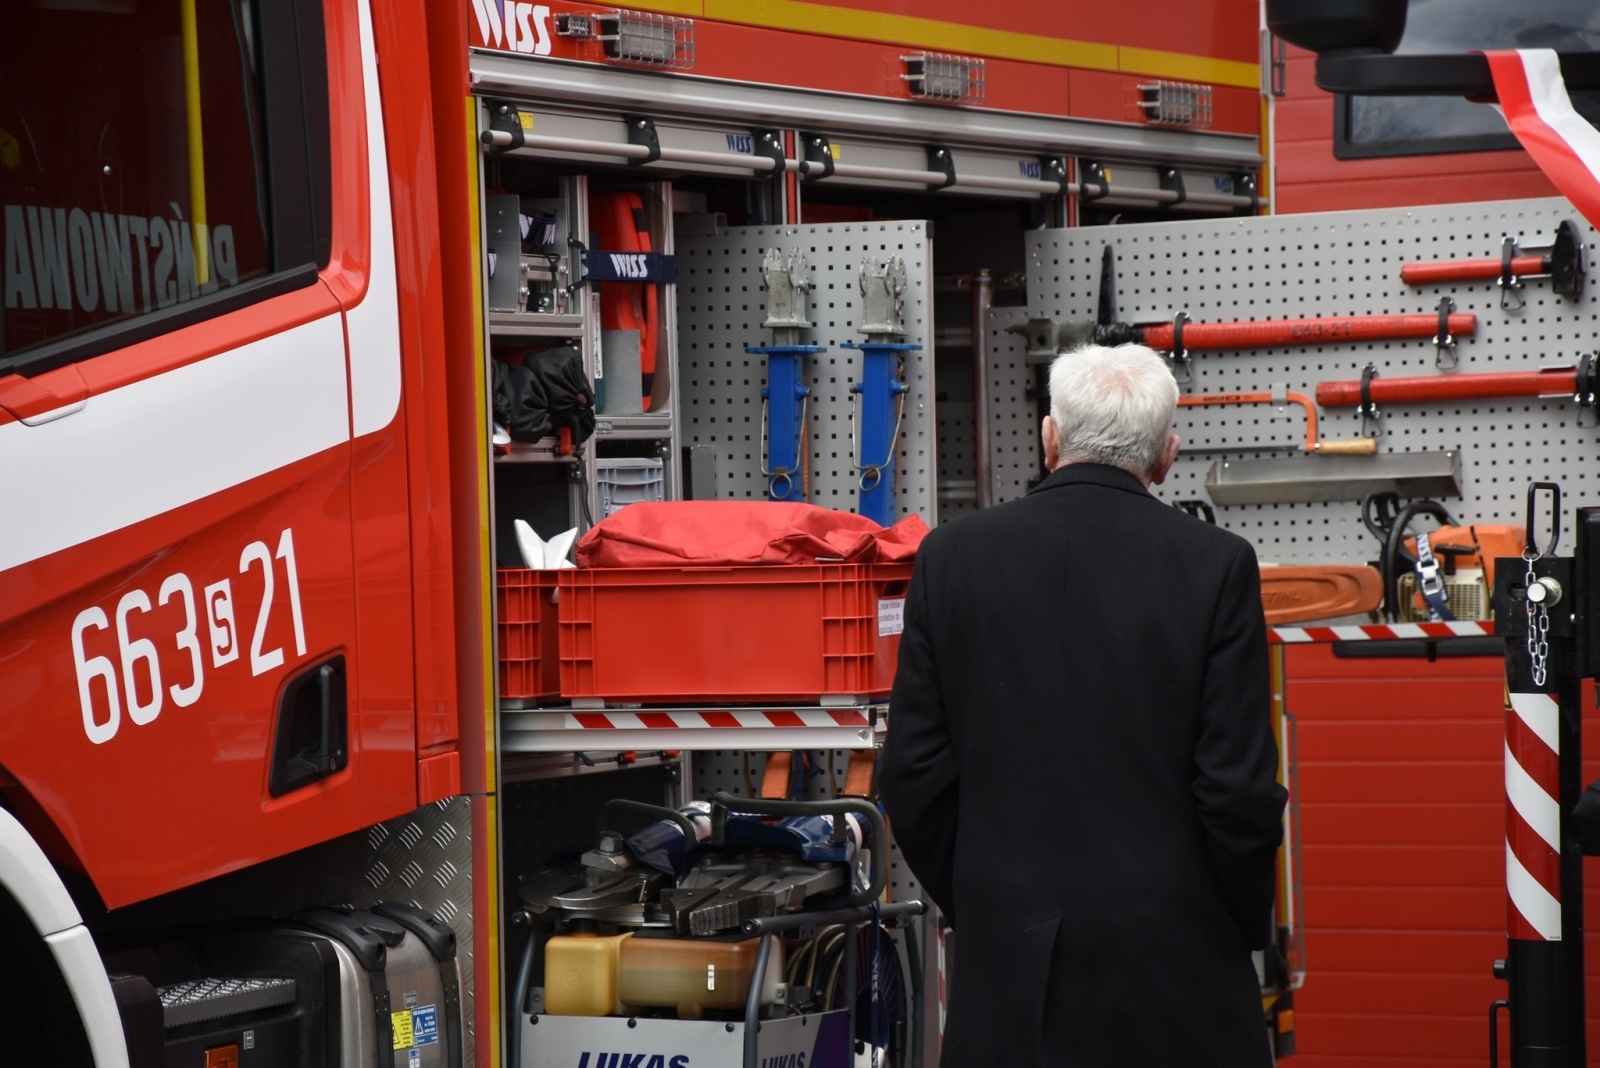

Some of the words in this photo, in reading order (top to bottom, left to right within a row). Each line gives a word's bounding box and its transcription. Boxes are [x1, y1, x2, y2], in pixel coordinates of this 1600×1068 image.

[472, 0, 551, 56] WISS
[725, 134, 751, 154] WISS
[1019, 161, 1040, 178] WISS
[1214, 176, 1232, 193] WISS
[610, 253, 648, 278] WISS
